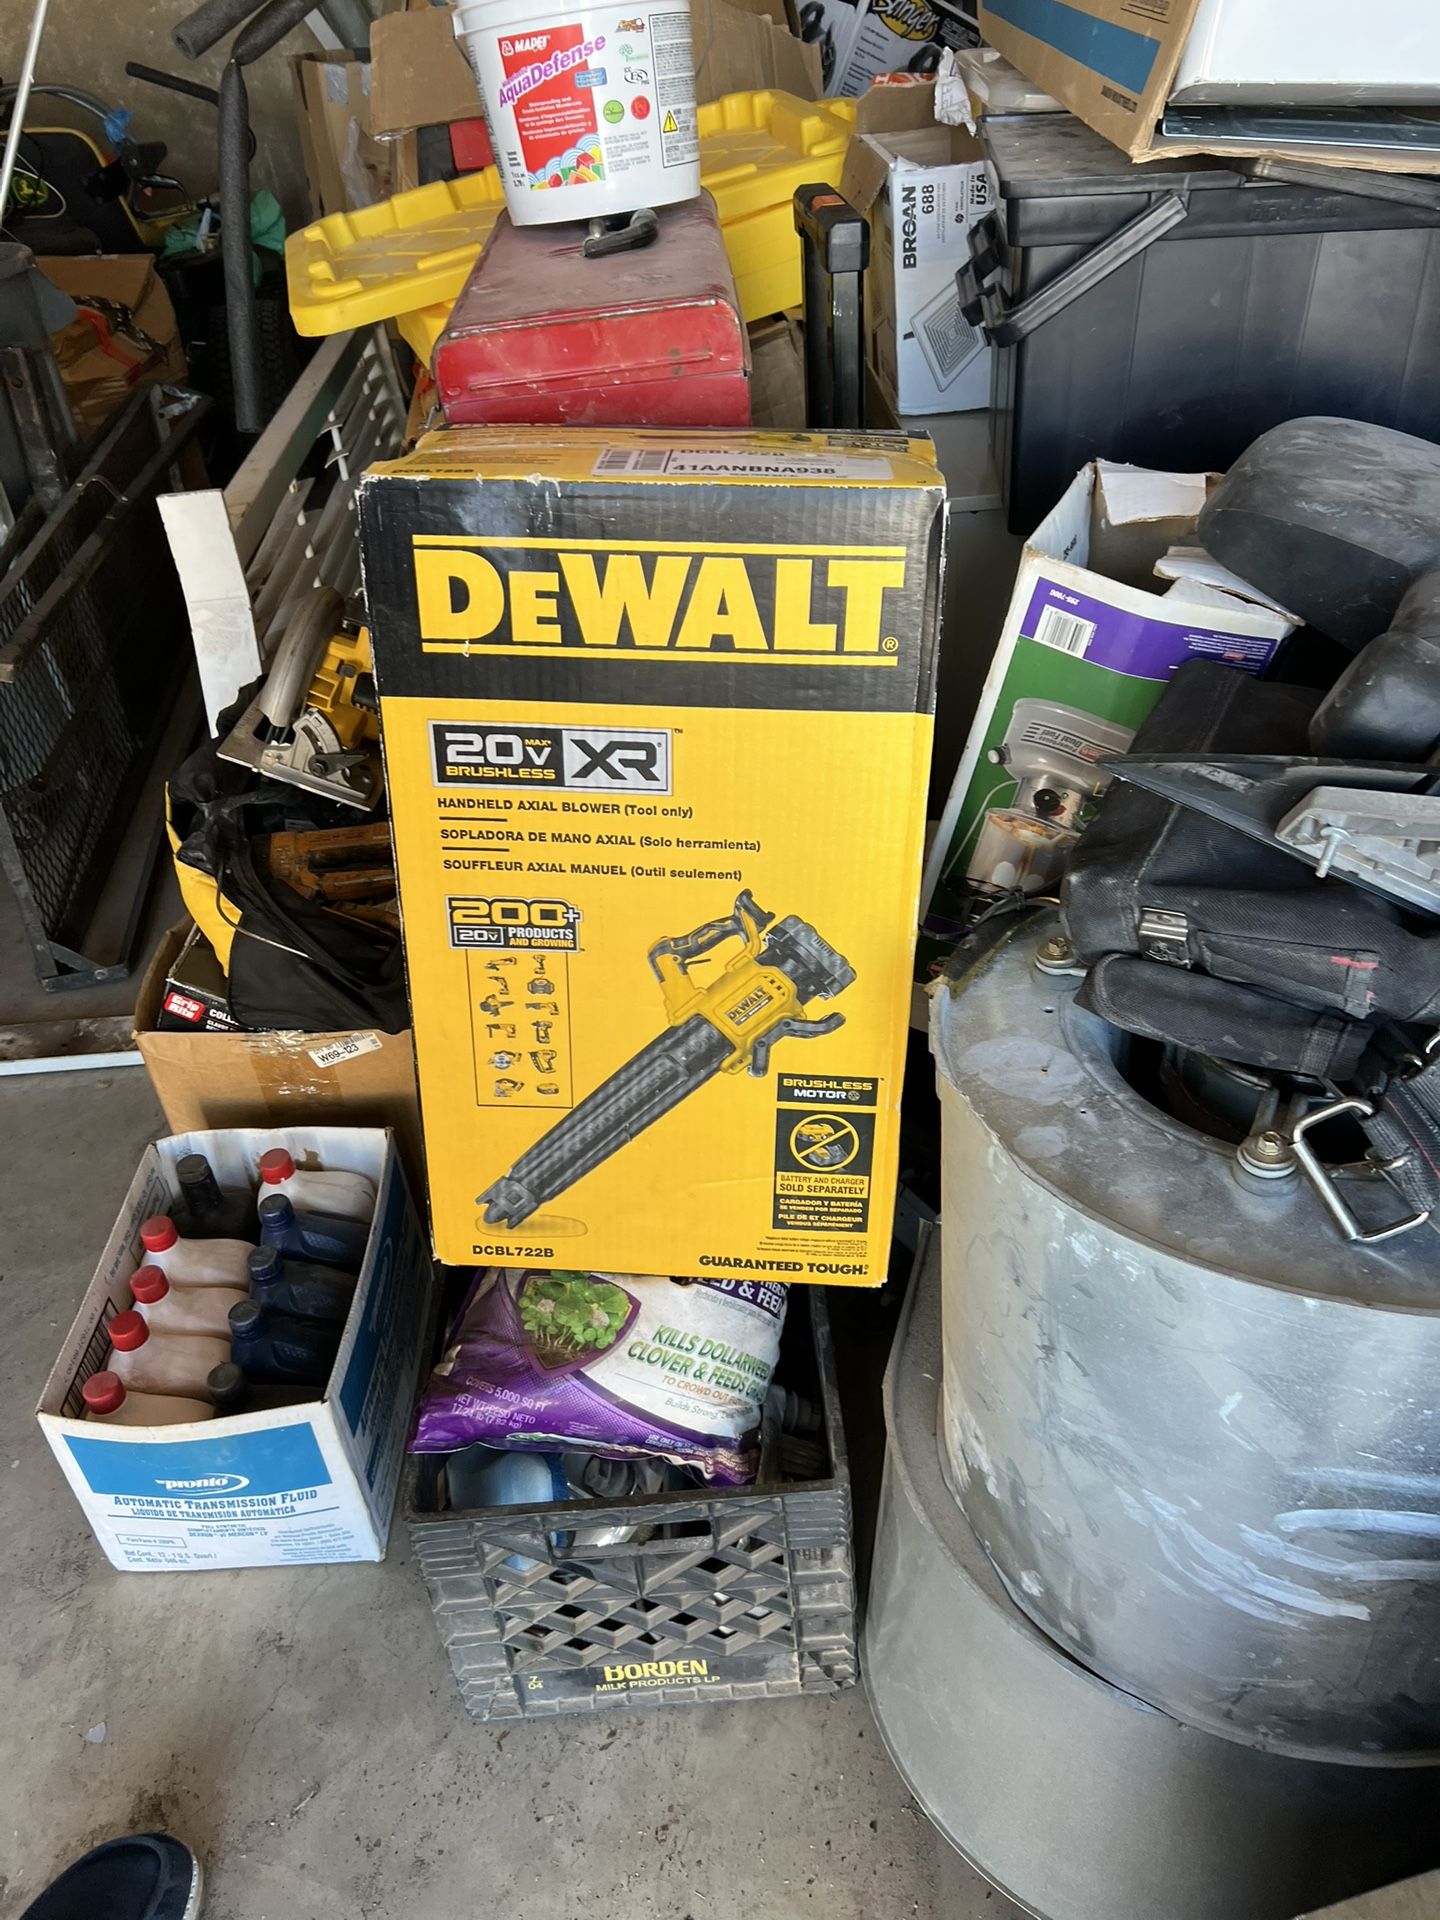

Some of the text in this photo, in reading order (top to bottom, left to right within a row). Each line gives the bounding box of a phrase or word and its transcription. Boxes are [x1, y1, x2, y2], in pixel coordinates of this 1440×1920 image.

[514, 35, 548, 52] MAPEI
[500, 36, 606, 108] AquaDefense
[976, 174, 987, 205] USA
[922, 184, 934, 214] 688
[902, 186, 917, 269] BROAN
[570, 738, 661, 782] XR
[446, 764, 557, 780] BRUSHLESS
[437, 797, 693, 819] HANDHELD AXIAL BLOWER (Tool only)
[440, 829, 761, 853] SOPLADORA DE MANO AXIAL (Solo herramienta)
[443, 859, 742, 881] SOUFFLEUR AXIAL MANUEL (Outil seulement)
[451, 900, 580, 927] 200+
[508, 927, 574, 939] PRODUCTS
[509, 938, 574, 948] AND GROWING
[171, 994, 200, 1012] Grip
[783, 1078, 873, 1091] BRUSHLESS
[794, 1089, 847, 1099] MOTOR
[780, 1174, 812, 1183] BATTERY
[831, 1177, 865, 1186] CHARGER
[780, 1183, 865, 1195] SOLD SEPARATELY
[779, 1198, 822, 1206] CARGADOR
[472, 1245, 554, 1257] DCBL722B
[699, 1255, 803, 1272] GUARANTEED
[738, 1281, 754, 1299] &
[652, 1325, 702, 1352] KILLS
[628, 1341, 694, 1376] CLOVER
[693, 1362, 707, 1380] &
[708, 1366, 746, 1393] FEEDS
[465, 1375, 547, 1412] COVERS 5,000 SQ FT
[662, 1374, 730, 1401] TO CROWD OUT
[455, 1393, 473, 1406] NET
[513, 1412, 536, 1424] NETO
[664, 1397, 690, 1412] Builds
[165, 1477, 229, 1489] pronto
[114, 1489, 318, 1510] AUTOMATIC TRANSMISSION FLUID
[603, 1659, 708, 1681] BORDEN
[528, 1682, 543, 1690] 04
[596, 1675, 721, 1692] MILK PRODUCTS LP
